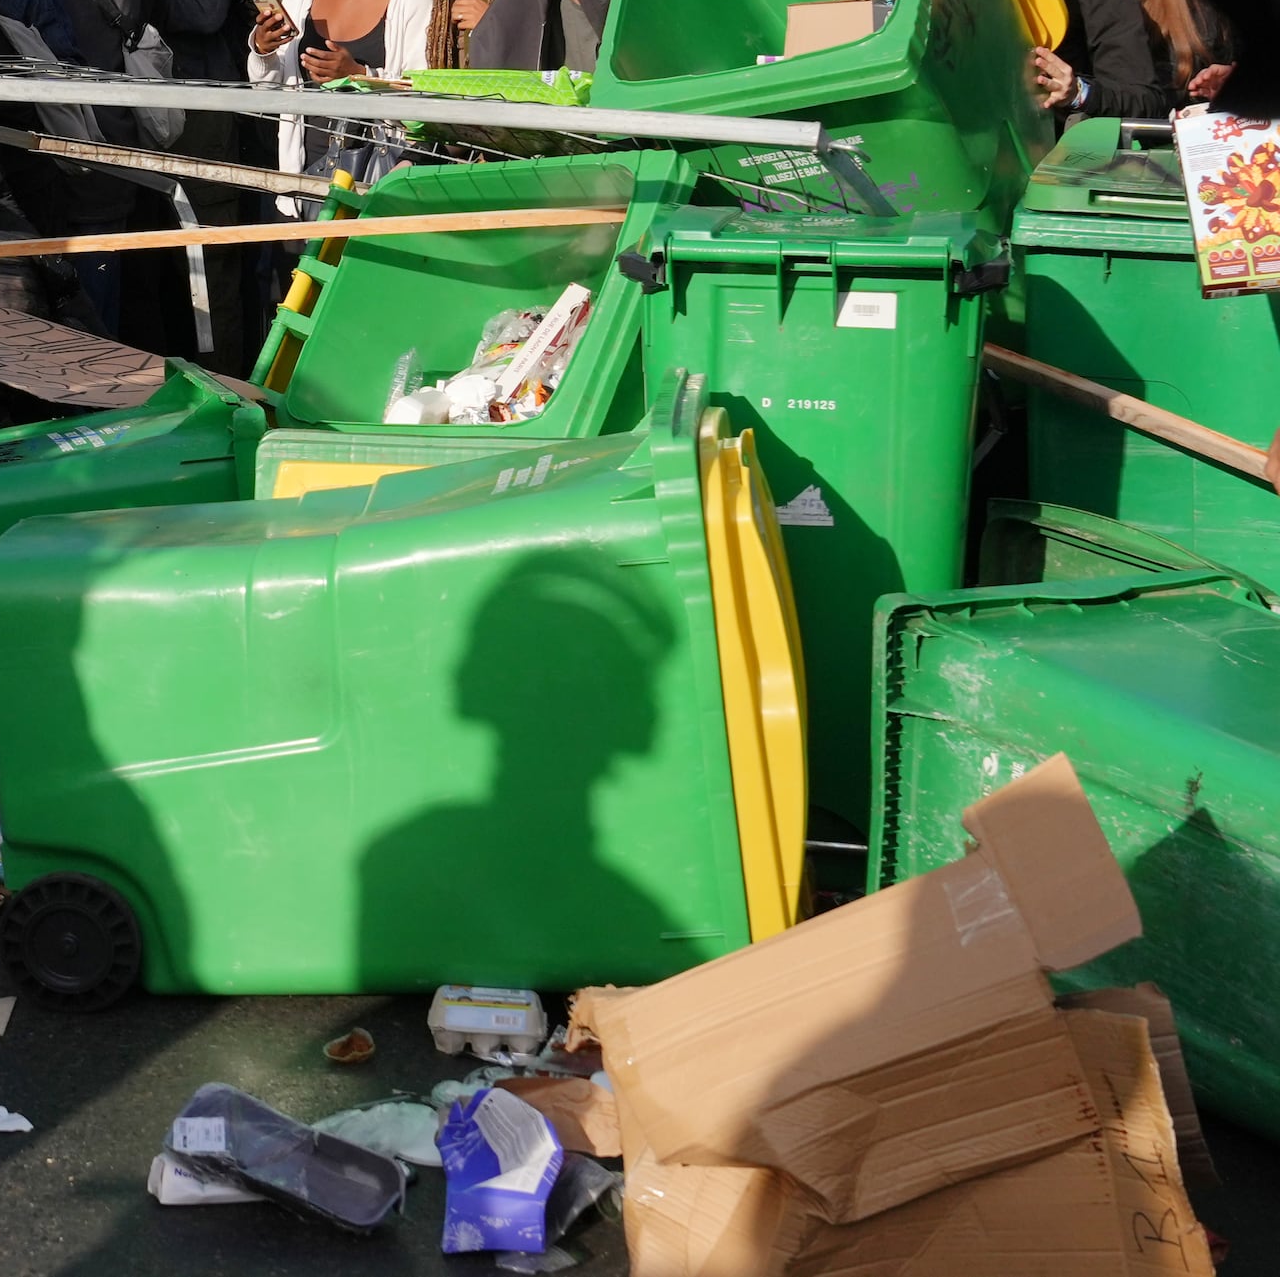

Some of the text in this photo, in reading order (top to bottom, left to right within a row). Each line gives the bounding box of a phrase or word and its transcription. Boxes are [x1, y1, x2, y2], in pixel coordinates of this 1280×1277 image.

[805, 165, 820, 177] BAC
[761, 397, 837, 410] D 219125
